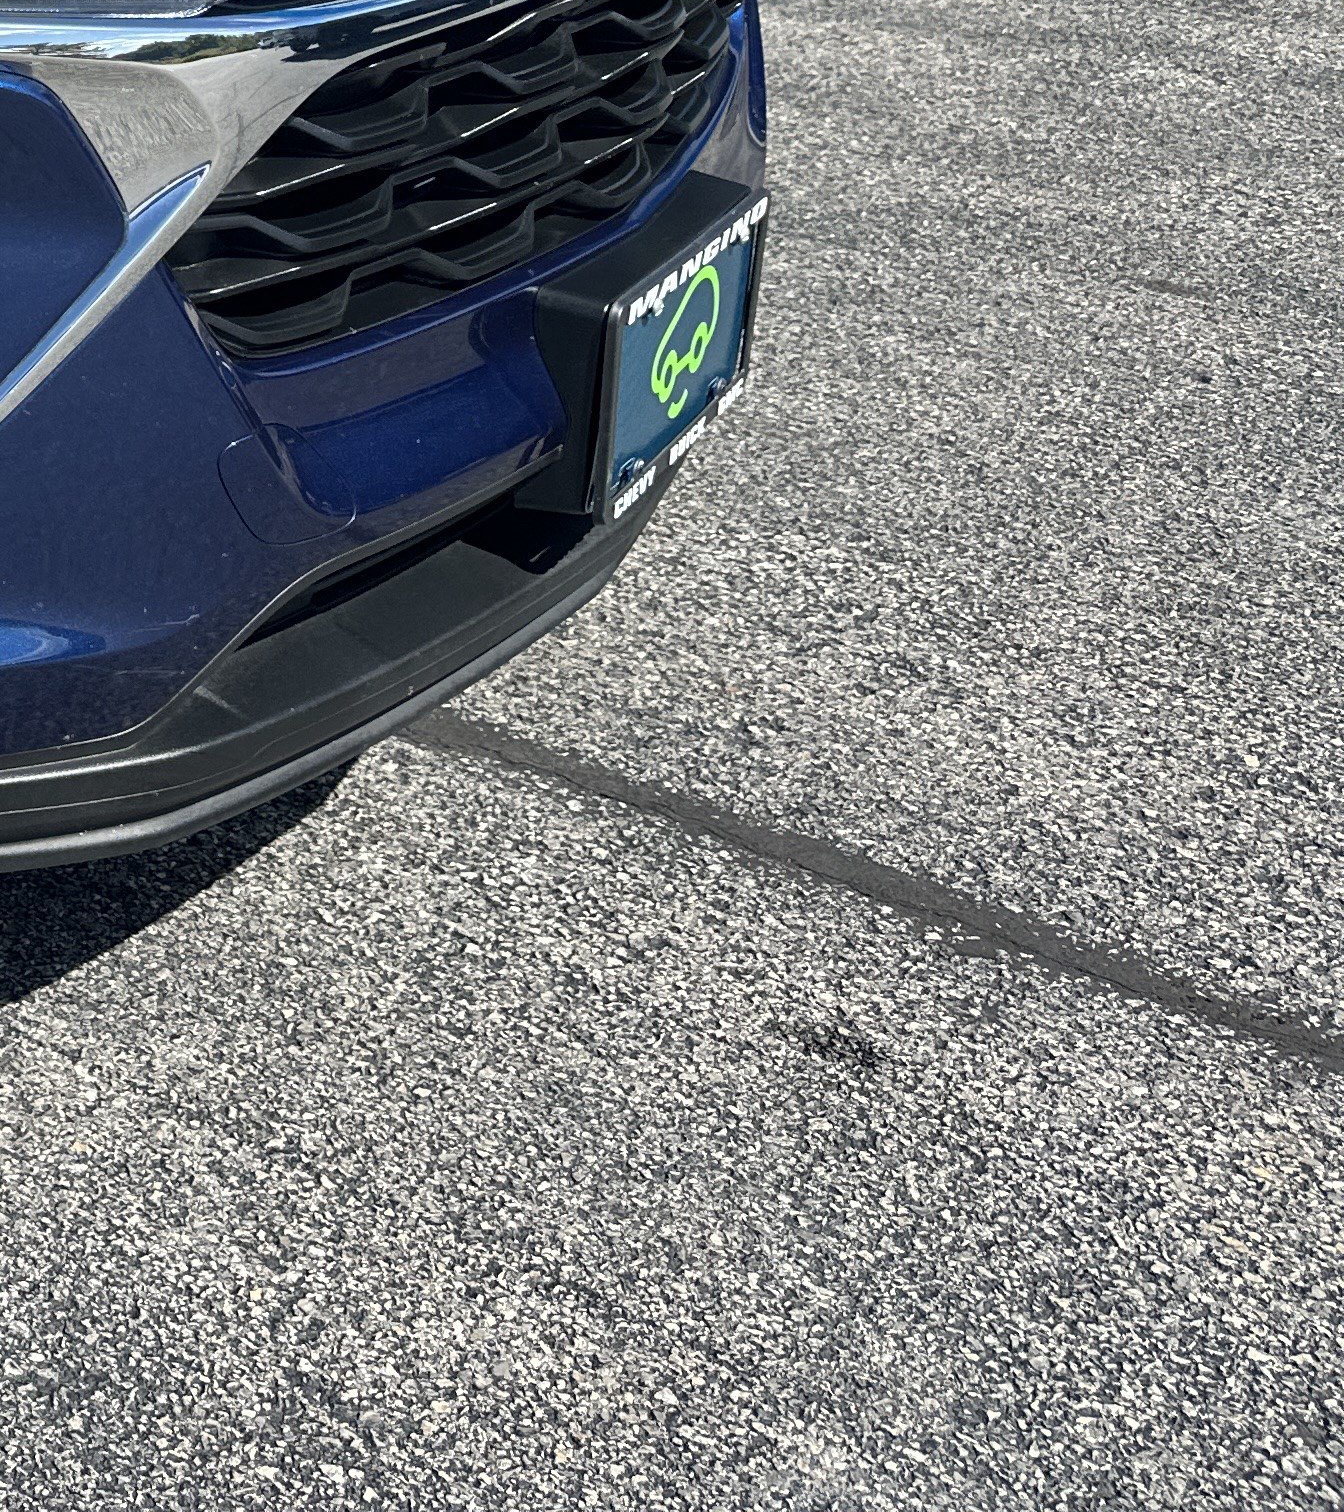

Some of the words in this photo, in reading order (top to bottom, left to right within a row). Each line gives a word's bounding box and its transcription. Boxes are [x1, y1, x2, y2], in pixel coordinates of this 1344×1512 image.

[628, 196, 768, 326] MANGINO
[613, 465, 657, 519] CHEVY
[669, 416, 707, 466] BUICK
